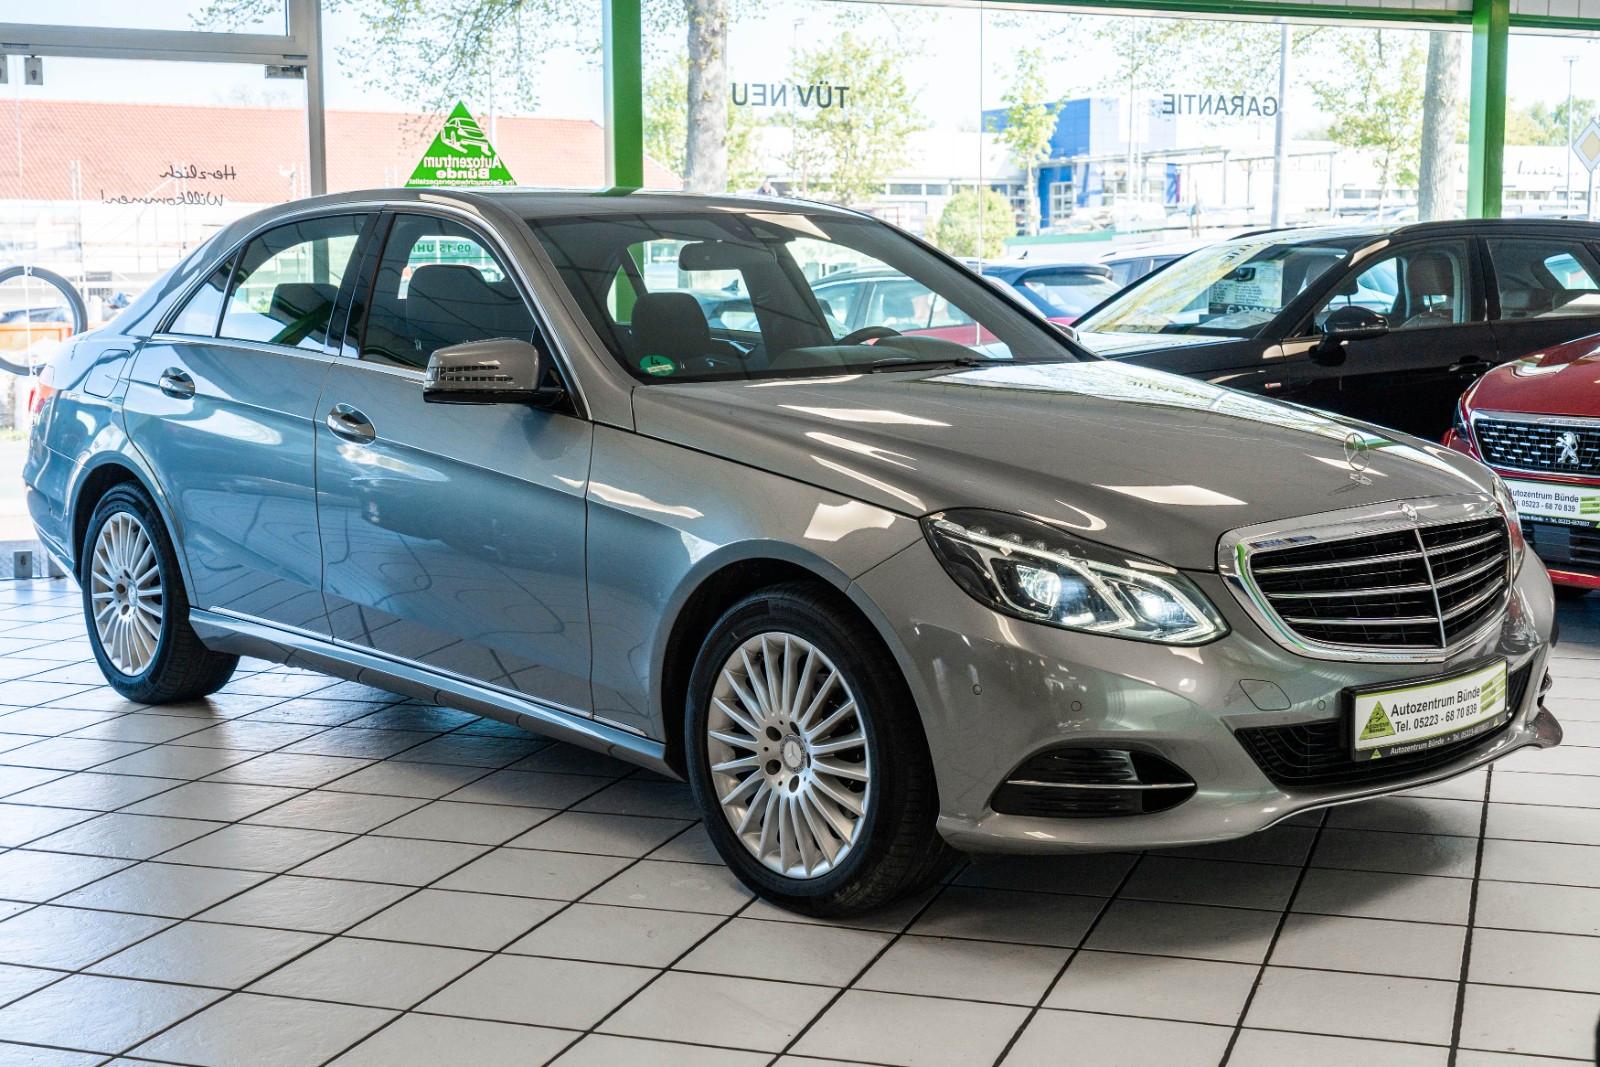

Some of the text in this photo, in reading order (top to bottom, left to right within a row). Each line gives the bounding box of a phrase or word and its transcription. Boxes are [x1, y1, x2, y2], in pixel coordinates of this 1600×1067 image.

[1554, 492, 1579, 503] Bünde
[1521, 500, 1540, 508] 05223
[1545, 502, 1553, 510] 68
[1554, 503, 1563, 511] 70
[1563, 504, 1576, 513] 839
[1390, 695, 1455, 717] Autozentrum
[1456, 686, 1481, 704] Bünde
[1395, 720, 1412, 733] Tel.
[1414, 714, 1439, 729] 05223
[1445, 710, 1455, 722] 68
[1456, 707, 1465, 719] 70
[1465, 703, 1478, 716] 839
[1390, 742, 1428, 755] Autozentrum
